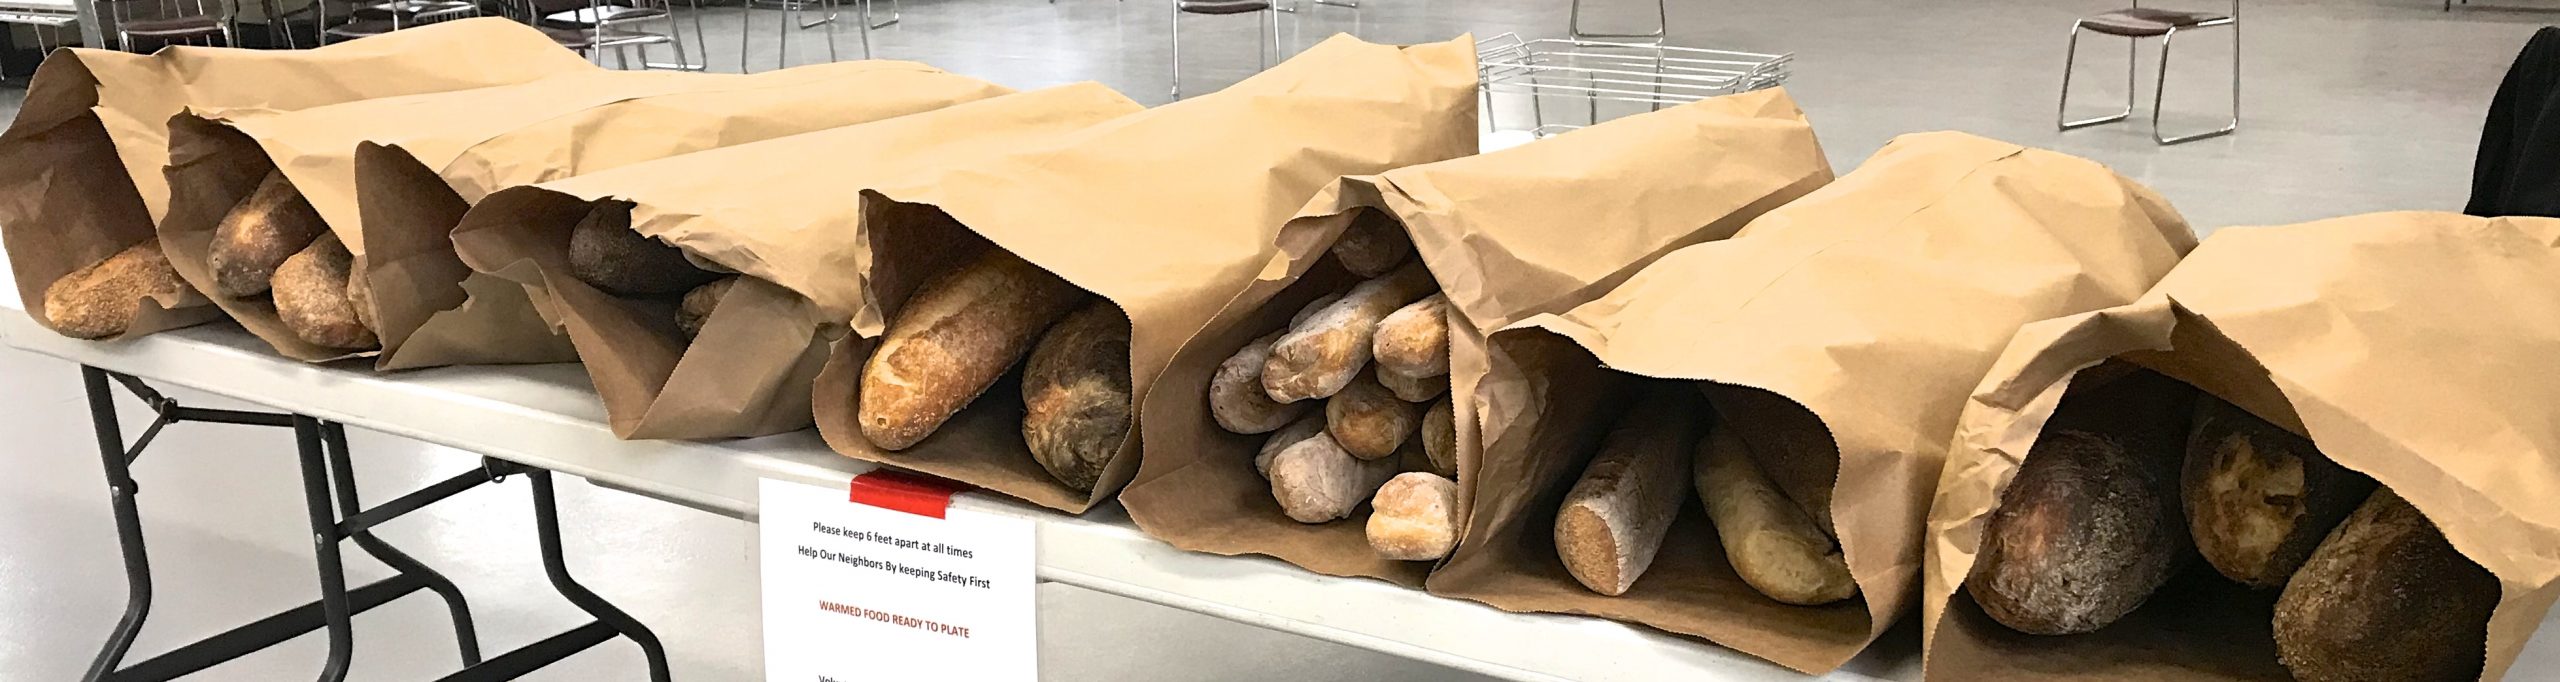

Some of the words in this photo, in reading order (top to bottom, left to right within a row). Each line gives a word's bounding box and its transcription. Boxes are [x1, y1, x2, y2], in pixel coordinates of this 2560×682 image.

[813, 521, 841, 536] Please
[843, 526, 865, 542] keep
[866, 531, 873, 542] 6
[874, 532, 893, 545] feet
[894, 537, 920, 550] apart
[921, 540, 931, 552] at
[932, 542, 945, 554] all
[946, 544, 974, 559] times
[798, 545, 818, 560] Help
[819, 549, 837, 561] Our
[838, 553, 884, 570] Neighbors
[885, 560, 897, 575] By
[898, 563, 936, 582] keeping
[937, 570, 968, 588] Safety
[969, 575, 991, 590] First
[819, 600, 862, 617] WARMED
[863, 608, 890, 623] FOOD
[892, 614, 923, 629] READY
[924, 620, 939, 633] TO
[940, 623, 970, 639] PLATE
